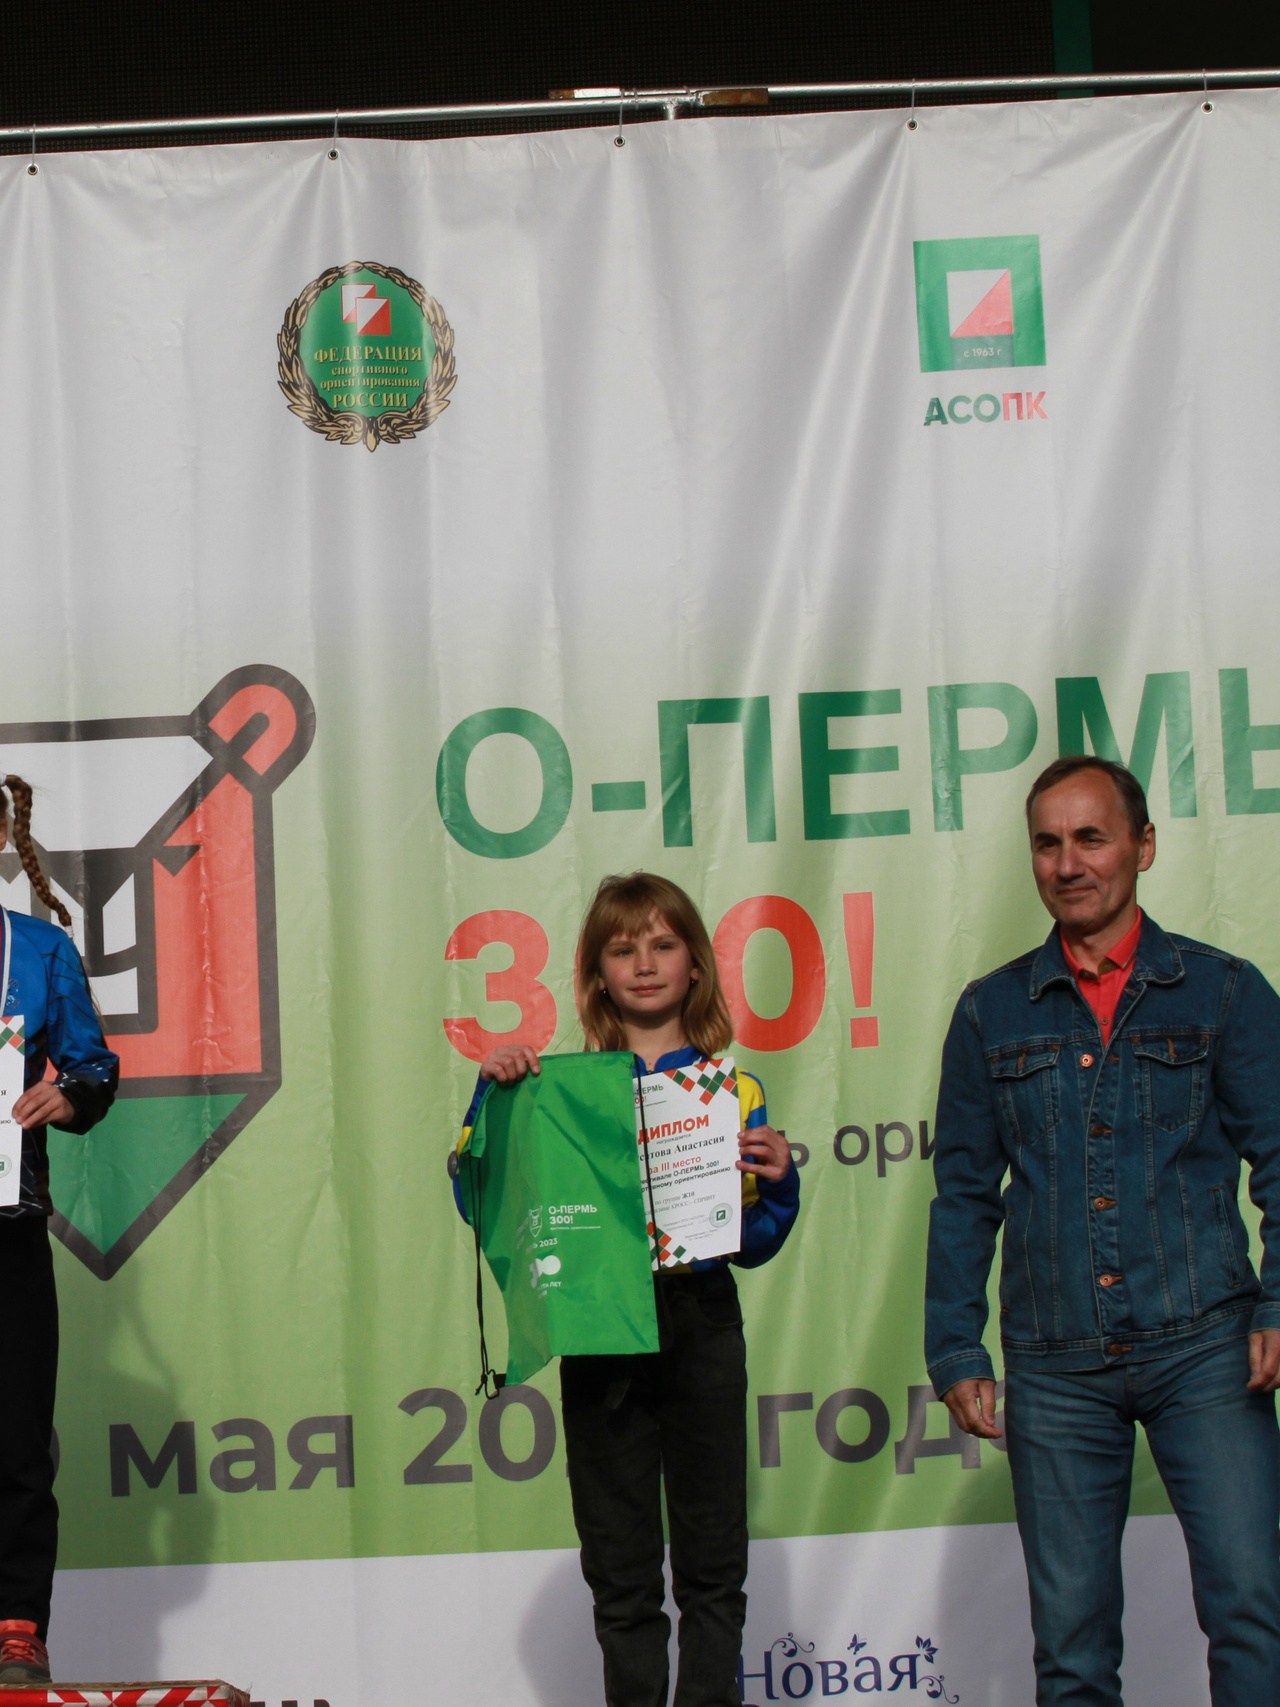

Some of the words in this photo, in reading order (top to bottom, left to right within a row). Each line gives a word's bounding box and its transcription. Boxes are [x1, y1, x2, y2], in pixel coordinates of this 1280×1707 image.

[314, 345, 423, 363] ФЕДЕРАЦИЯ
[972, 347, 995, 357] 1963
[331, 364, 409, 379] спортивного
[320, 377, 421, 392] ориентирования
[333, 393, 408, 409] РОССИИ
[923, 391, 1049, 426] АСОПК
[442, 891, 880, 1066] 30!
[674, 1135, 725, 1154] Анастасия
[672, 1156, 702, 1169] место
[673, 1165, 705, 1177] О-ПЕРМЬ
[674, 1166, 731, 1184] ориентированию
[548, 1204, 598, 1215] О-ПЕРМЬ
[549, 1215, 574, 1225] 300!
[540, 1238, 558, 1248] 2023
[108, 1414, 356, 1498] мая
[397, 1384, 568, 1485] 20
